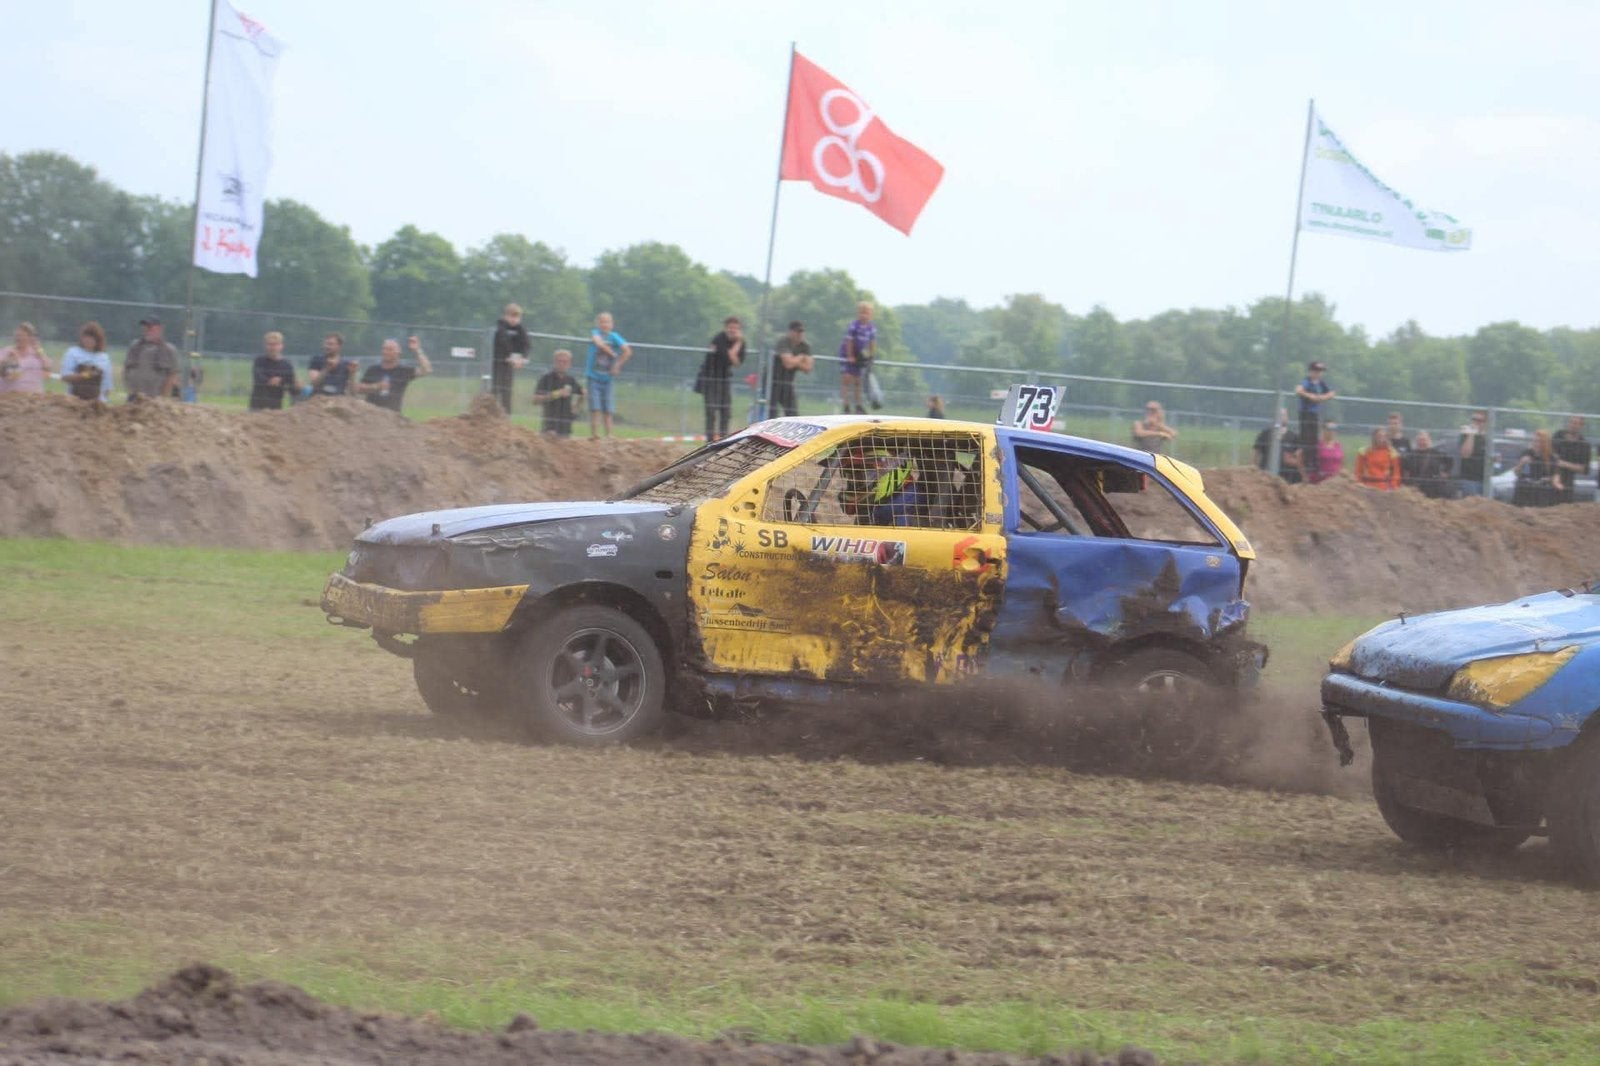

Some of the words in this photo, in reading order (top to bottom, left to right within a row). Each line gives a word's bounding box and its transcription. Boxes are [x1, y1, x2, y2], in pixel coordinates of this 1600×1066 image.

[1016, 386, 1053, 425] 73
[759, 529, 790, 549] SB
[811, 536, 878, 554] WIHO
